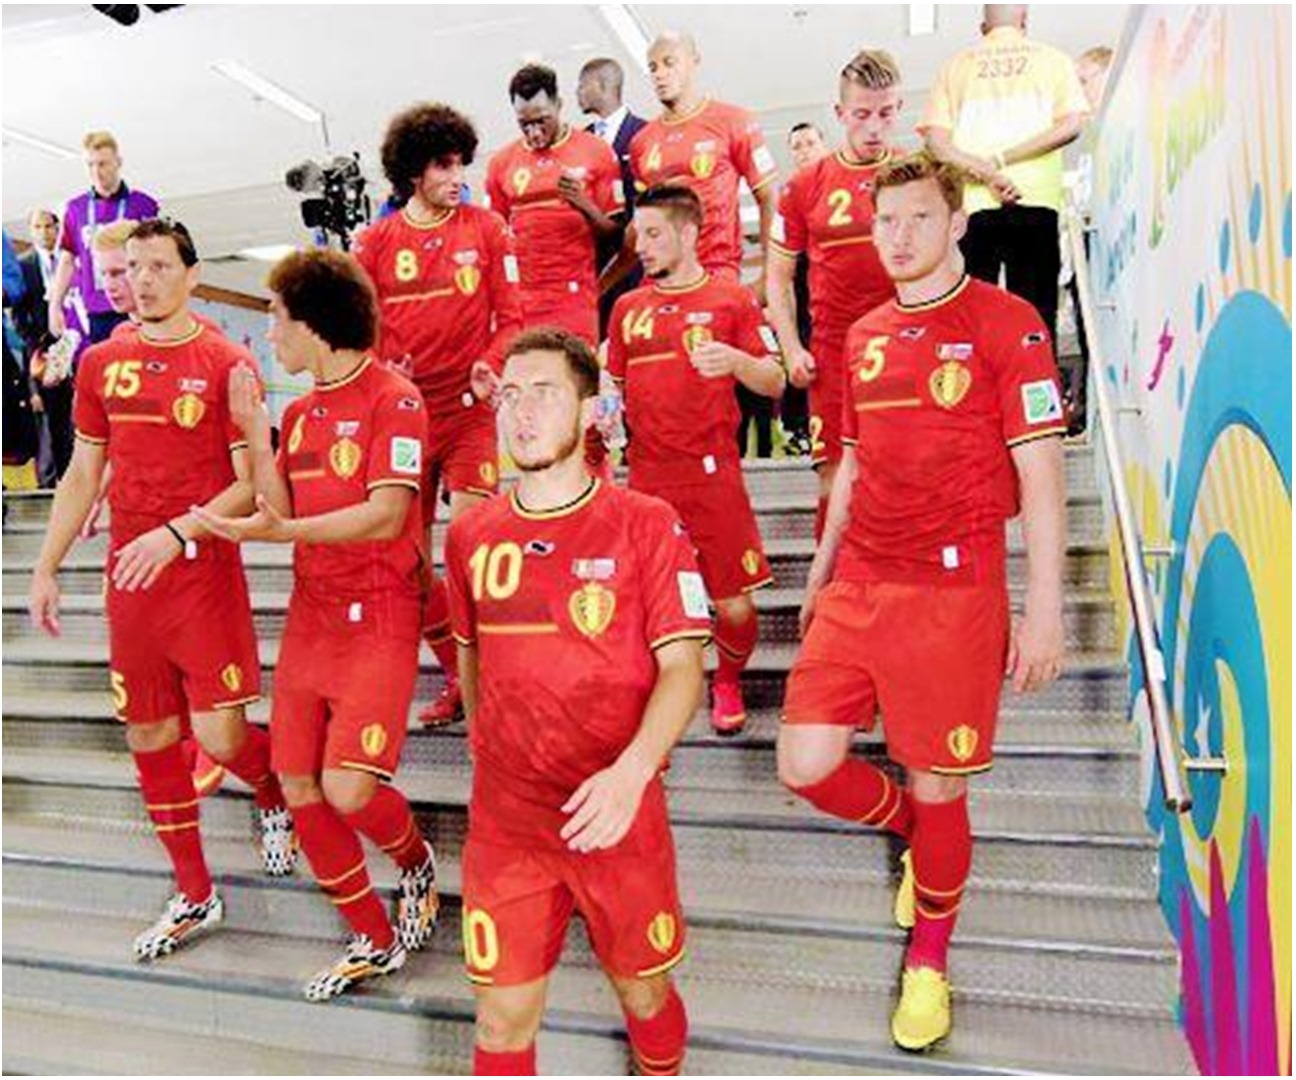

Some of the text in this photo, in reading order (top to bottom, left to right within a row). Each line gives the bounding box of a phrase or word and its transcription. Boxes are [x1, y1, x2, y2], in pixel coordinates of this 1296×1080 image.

[512, 166, 532, 196] 9
[827, 188, 852, 226] 2
[395, 248, 418, 281] 8
[621, 307, 654, 344] 14
[858, 335, 890, 382] 5
[103, 360, 143, 399] 15
[469, 541, 523, 600] 10
